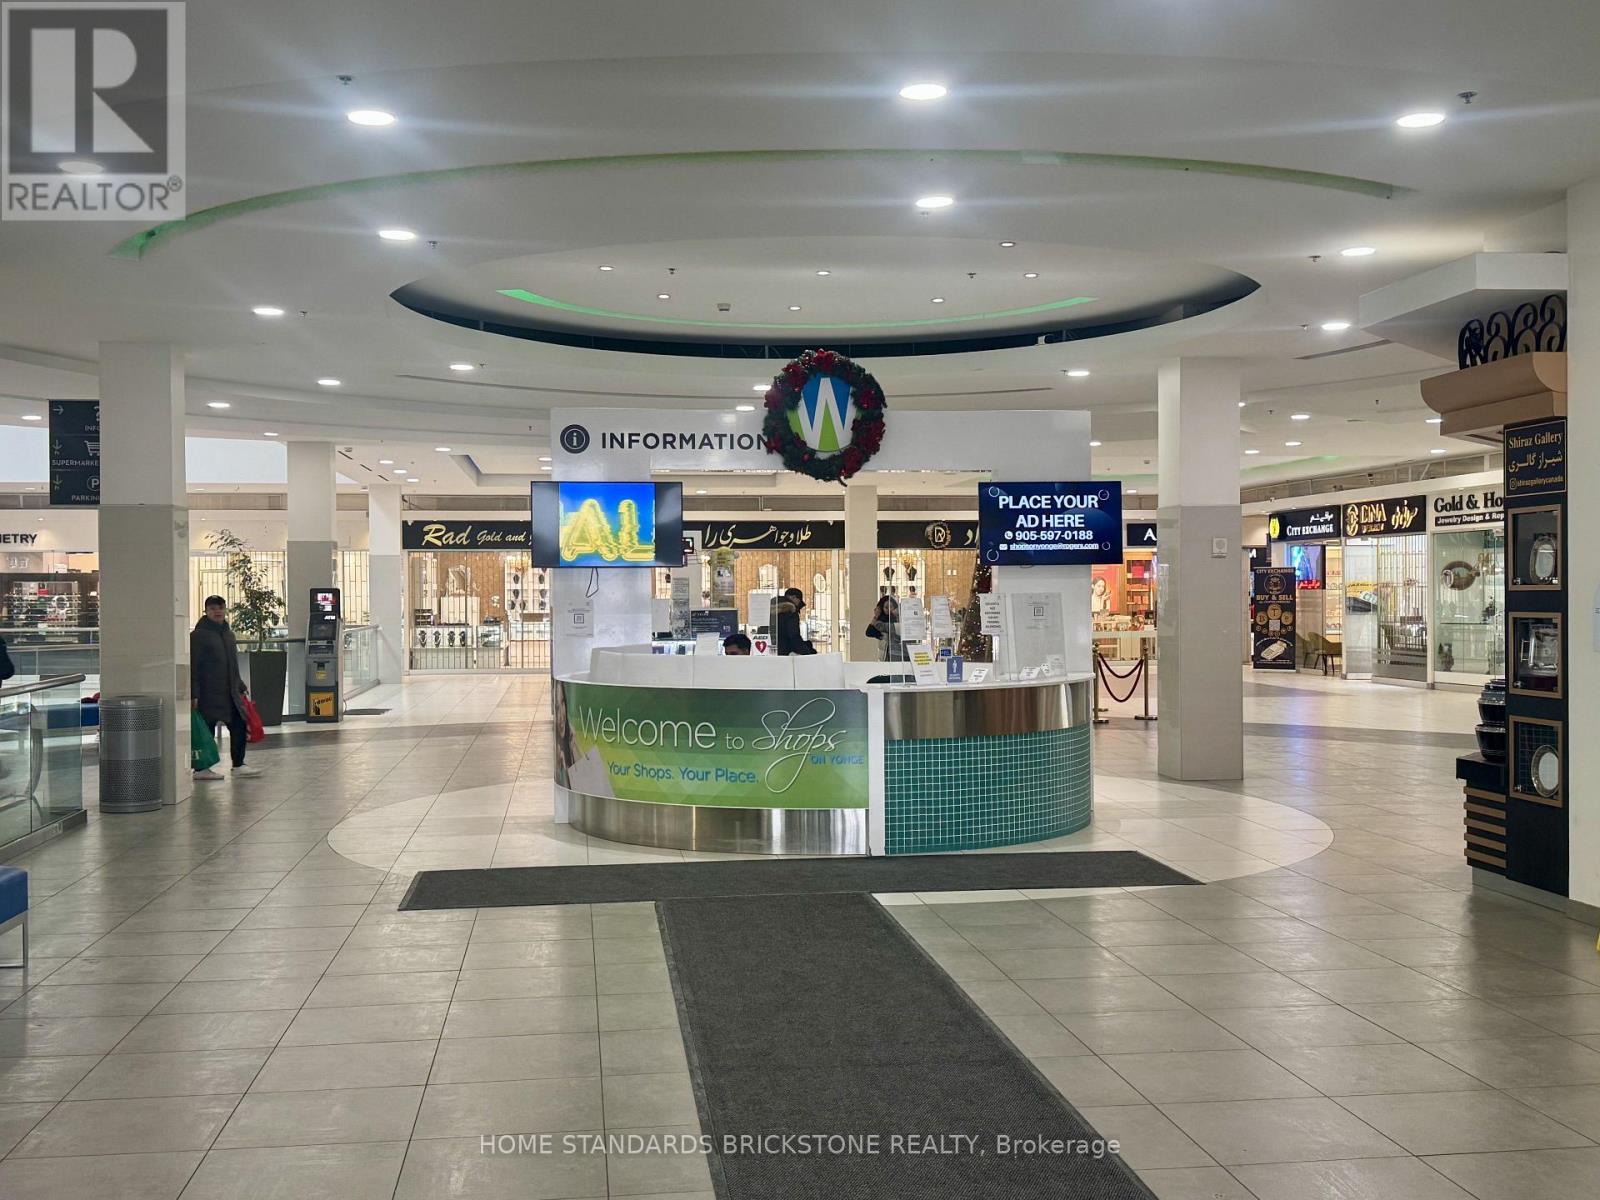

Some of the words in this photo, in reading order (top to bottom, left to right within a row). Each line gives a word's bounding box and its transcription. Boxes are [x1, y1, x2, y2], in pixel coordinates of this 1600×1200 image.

[1509, 435, 1533, 449] Shiraz
[1535, 431, 1562, 445] Gallery
[998, 495, 1051, 509] PLACE
[1053, 494, 1099, 509] YOUR
[1434, 495, 1463, 513] Gold
[1466, 494, 1480, 510] &
[1015, 514, 1040, 528] AD
[1042, 514, 1085, 528] HERE
[1437, 515, 1461, 525] Jewelry
[1462, 513, 1484, 523] Design
[421, 523, 472, 547] Rad
[476, 530, 503, 545] Gold
[505, 531, 527, 542] and
[1015, 530, 1093, 540] 905-597-0188
[1302, 523, 1334, 536] EXCHANGE
[0, 533, 38, 544] ETRY
[579, 705, 716, 748] Welcome
[726, 733, 745, 750] to
[752, 697, 847, 793] Shops
[608, 761, 630, 777] Your
[633, 763, 674, 781] Shops.
[678, 766, 711, 781] Your
[714, 767, 760, 784] Place.
